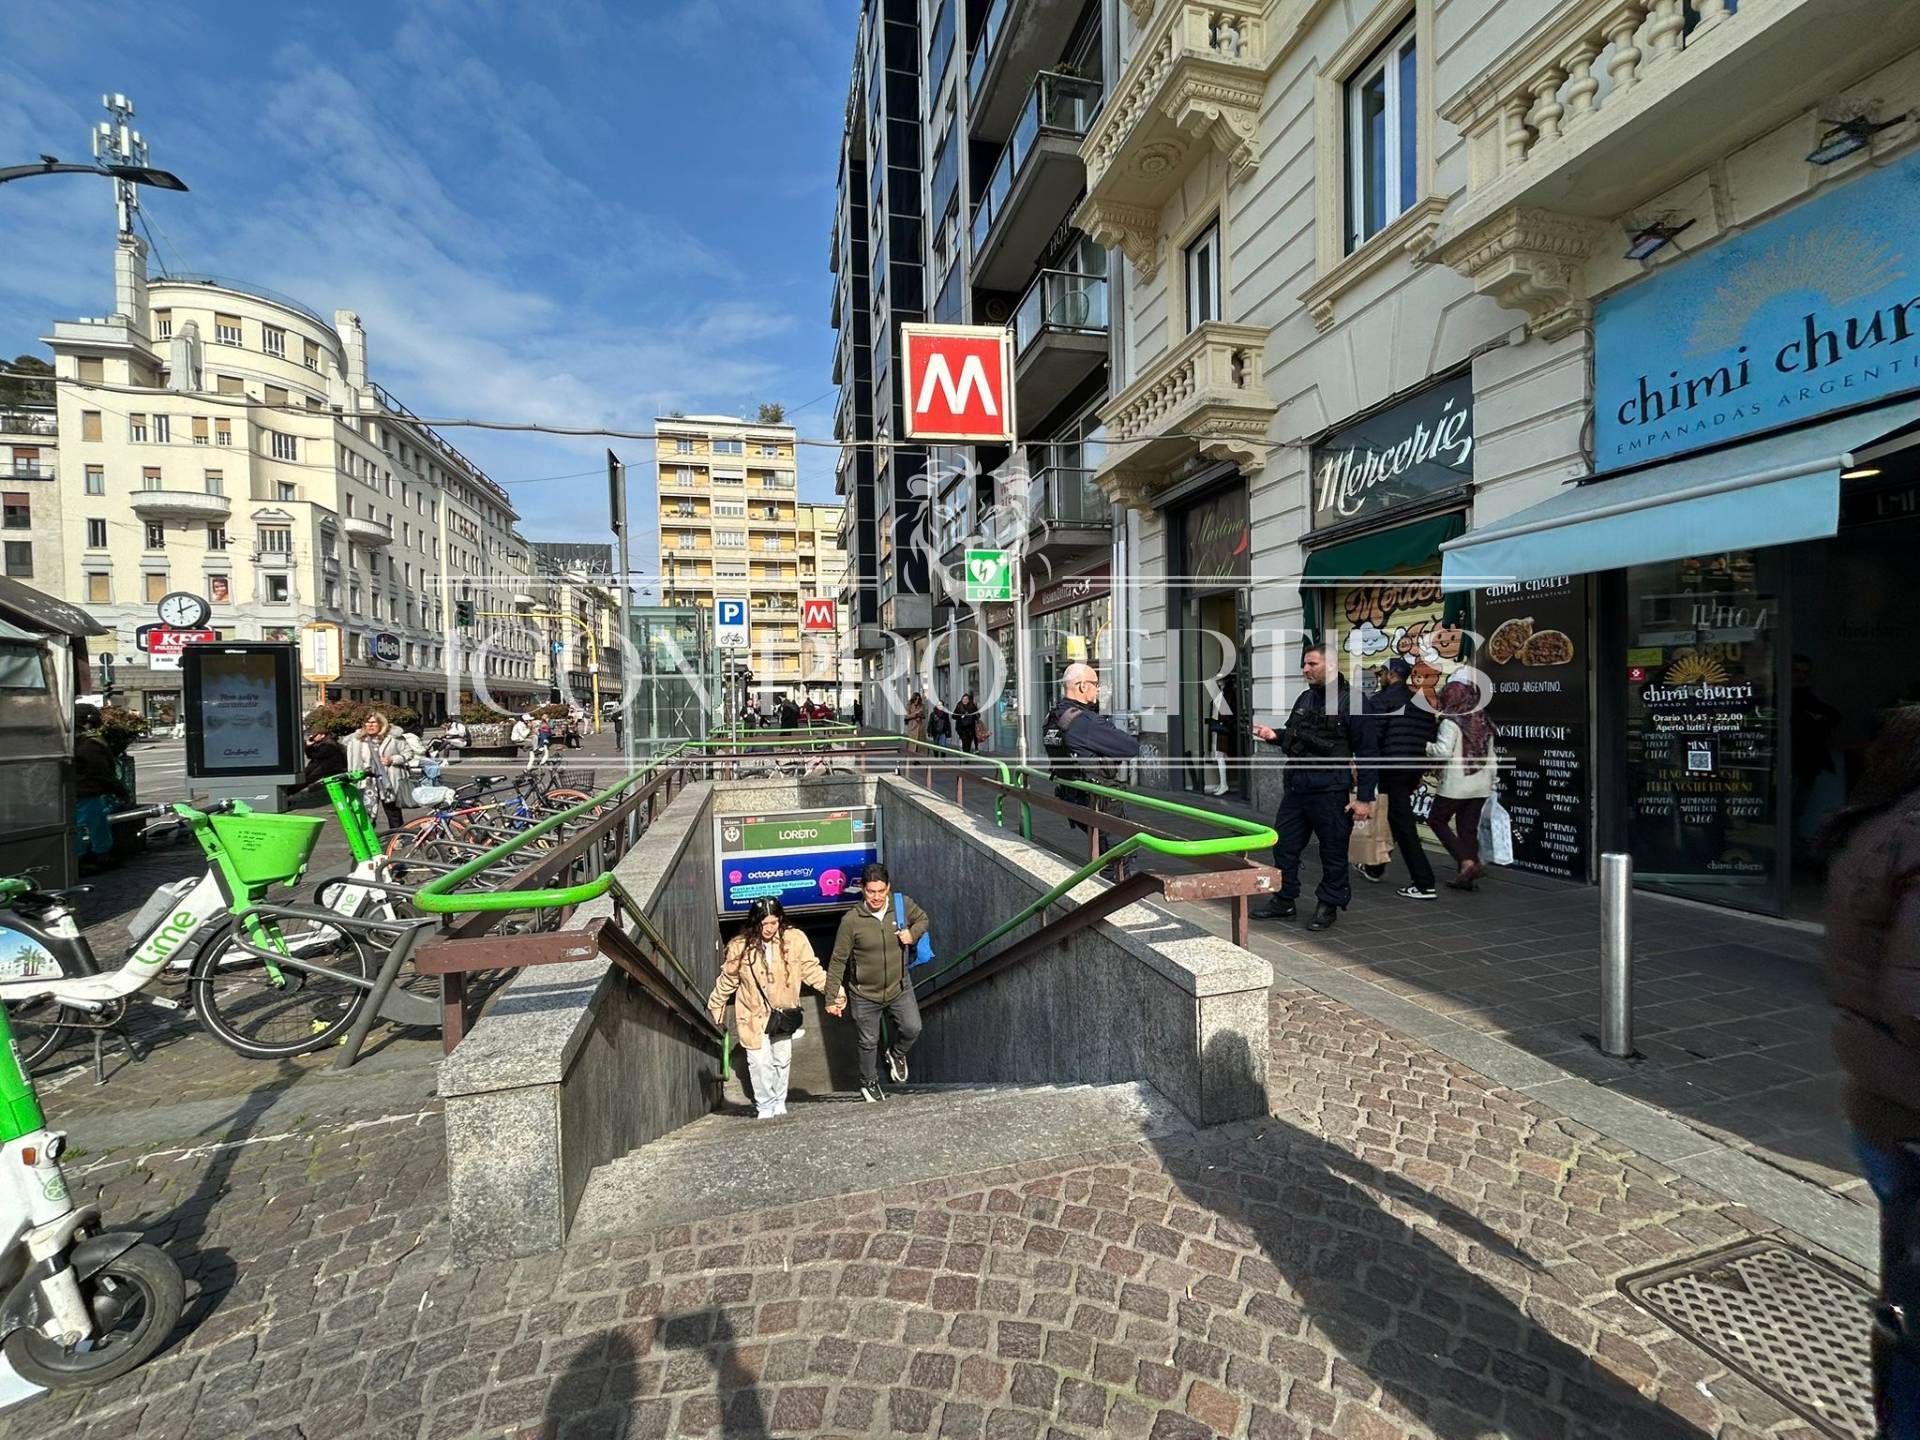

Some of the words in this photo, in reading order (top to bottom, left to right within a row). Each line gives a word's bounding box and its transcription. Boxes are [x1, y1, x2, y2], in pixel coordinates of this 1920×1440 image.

[916, 352, 998, 416] M
[1617, 346, 1750, 426] chimi
[1616, 402, 1761, 455] EMPANADAS
[977, 588, 1000, 598] DAE
[724, 603, 740, 623] P
[807, 605, 832, 623] M
[160, 632, 205, 645] KFC
[1500, 682, 1520, 693] GUSTO
[1643, 683, 1689, 702] chimi
[1695, 681, 1753, 700] churri
[1652, 714, 1681, 723] Orario
[1716, 713, 1743, 722] 22,00
[1656, 723, 1684, 733] Aperto
[1686, 722, 1705, 731] tutti
[1713, 721, 1740, 733] giorni
[779, 829, 818, 840] LORETO
[135, 911, 198, 965] Lime
